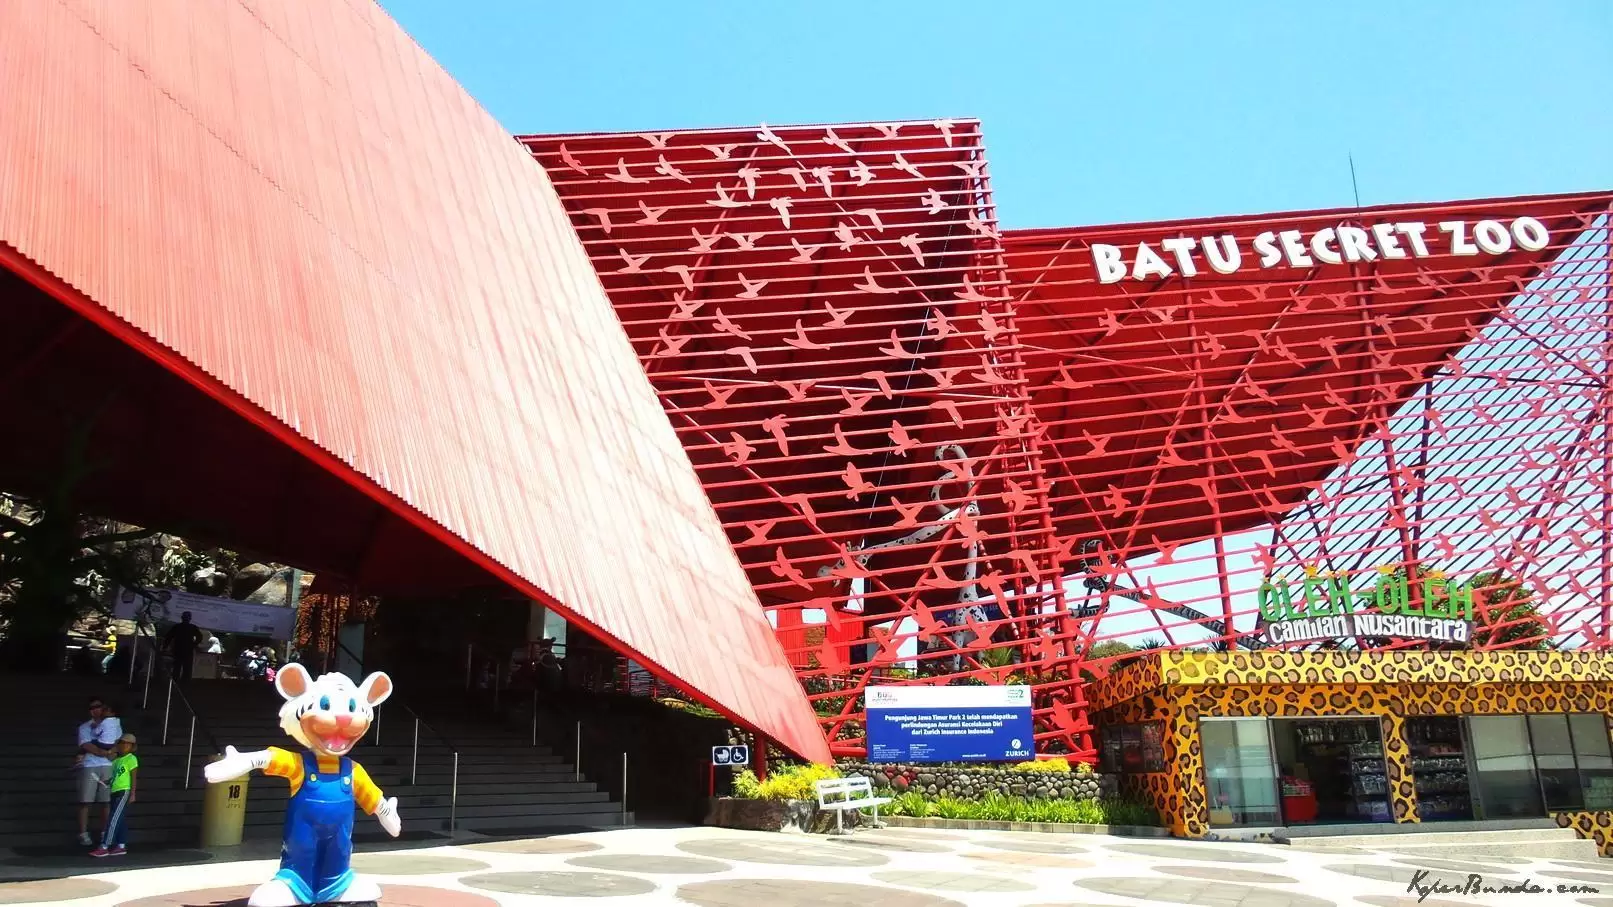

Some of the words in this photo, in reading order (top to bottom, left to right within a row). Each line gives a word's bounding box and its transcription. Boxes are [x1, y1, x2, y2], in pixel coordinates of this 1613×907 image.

[1090, 233, 1242, 284] BATU
[1252, 221, 1429, 268] SECRET
[1438, 216, 1550, 255] ZOO
[1258, 575, 1473, 621] OLEH-OLEH
[228, 784, 241, 799] 18
